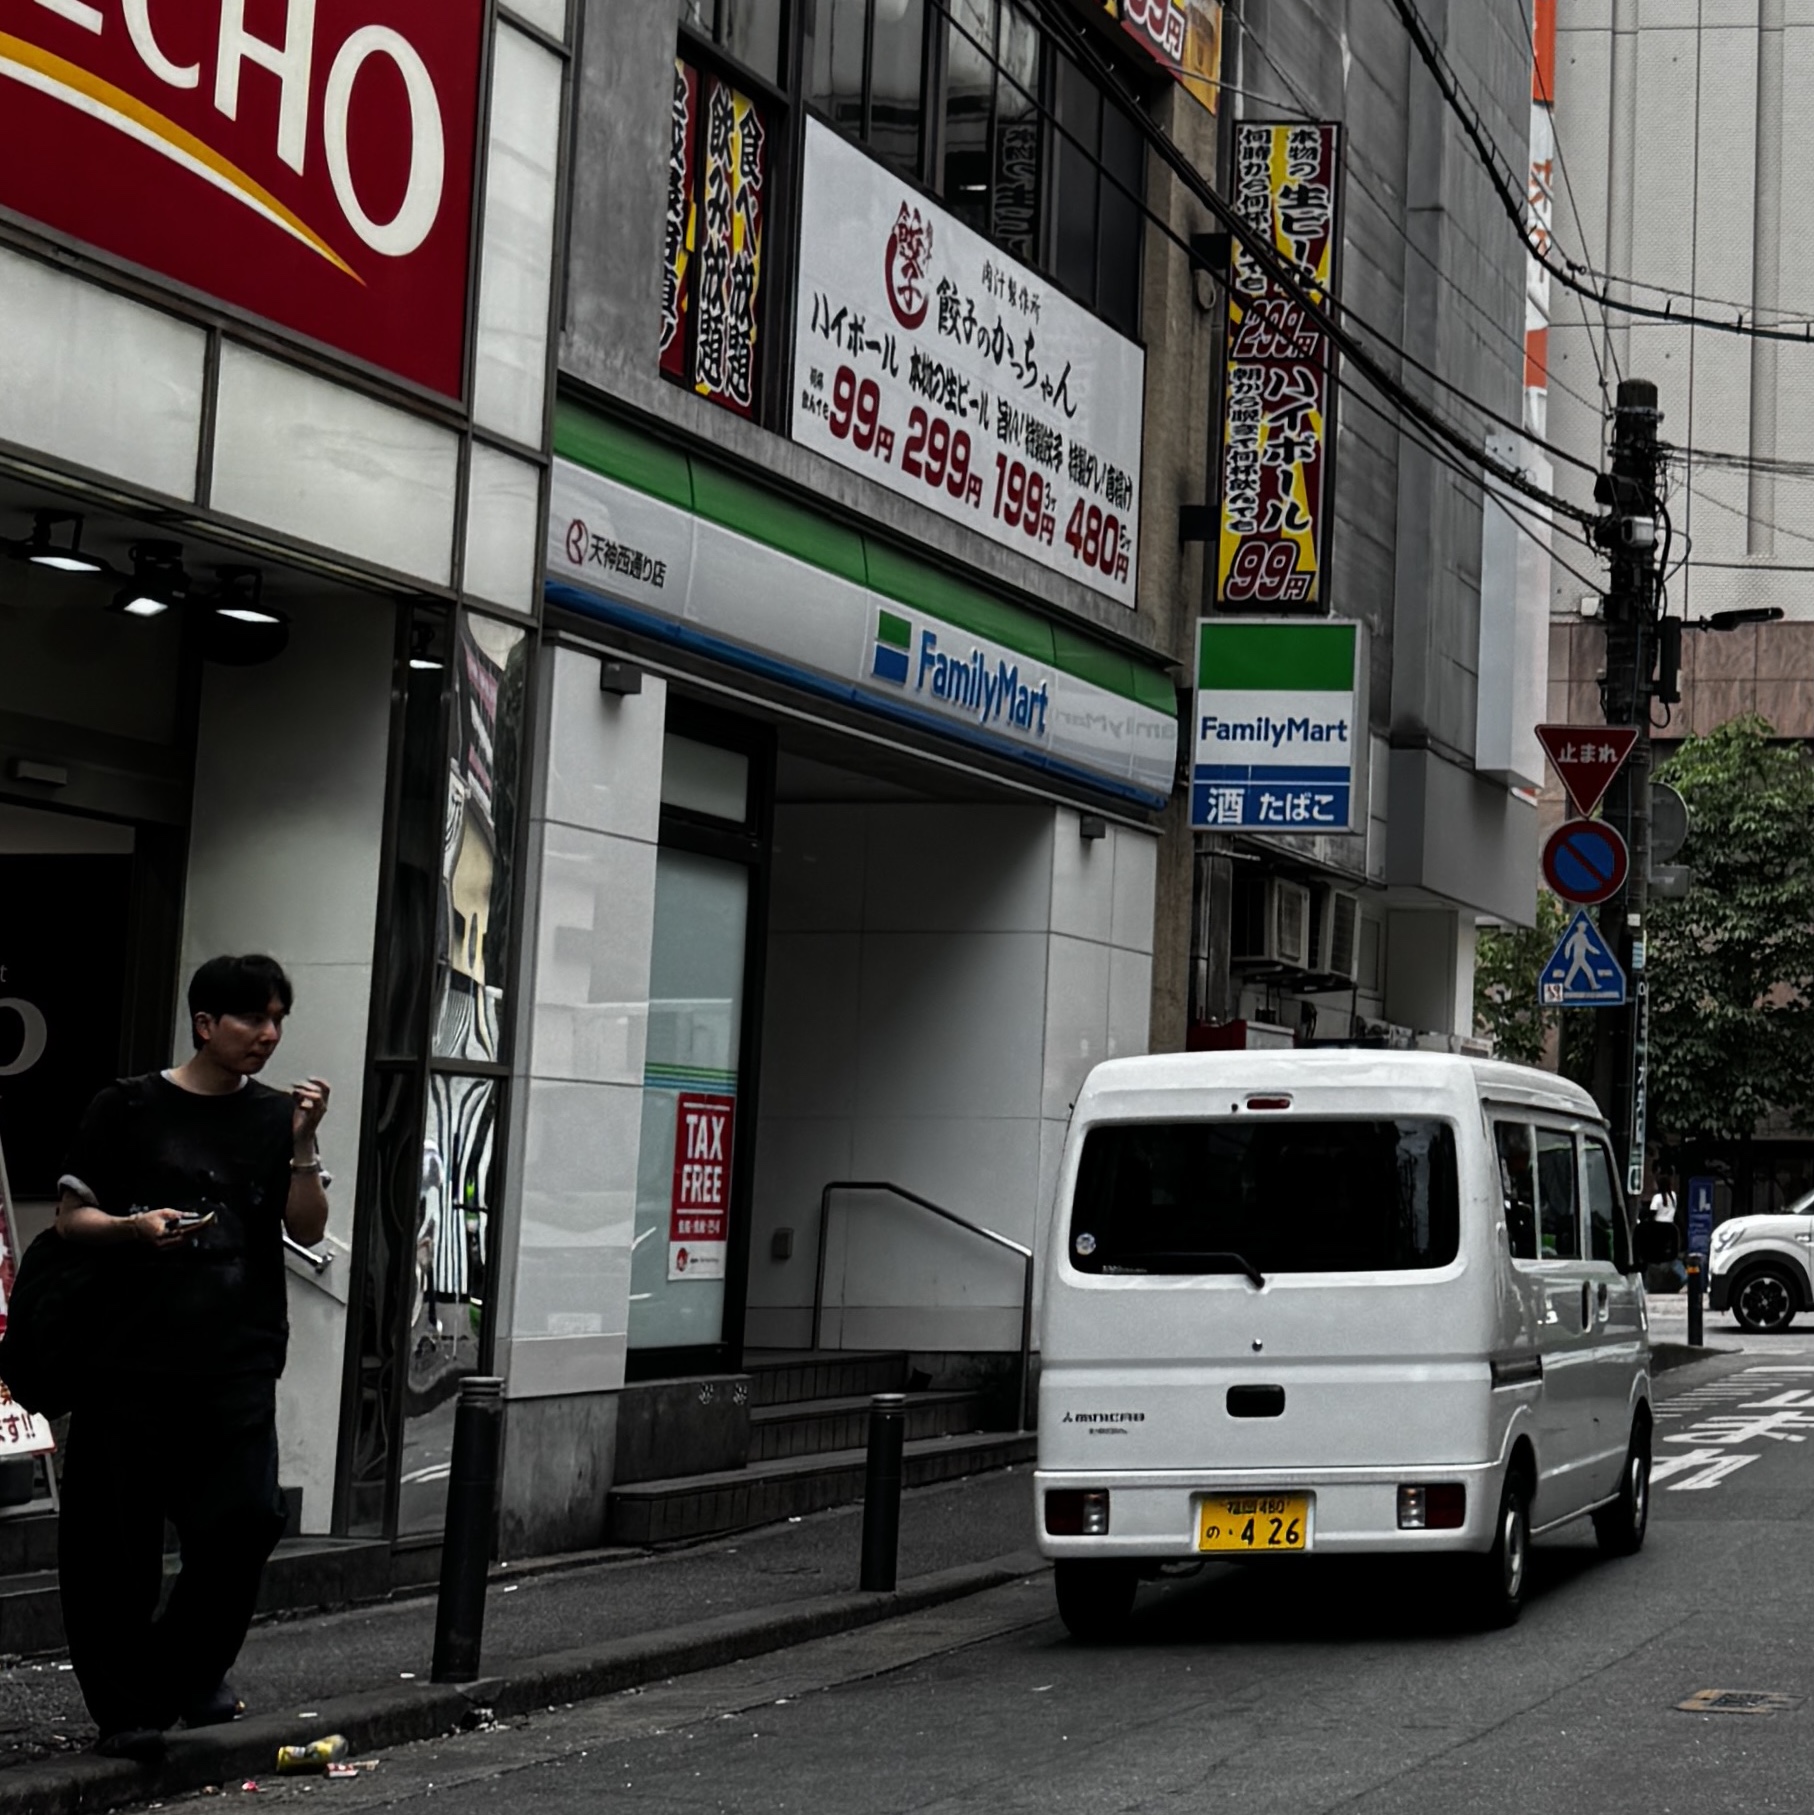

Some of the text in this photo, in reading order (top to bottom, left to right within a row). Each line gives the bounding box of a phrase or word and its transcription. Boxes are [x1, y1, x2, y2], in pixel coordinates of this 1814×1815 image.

[812, 291, 898, 378] ハイボール
[936, 276, 1077, 418] 餃子のかっちゃん
[1260, 366, 1318, 533] ハイボール
[588, 533, 667, 590] 天神西通り店
[1225, 541, 1311, 600] 99円
[917, 630, 1050, 738] FamilyMart
[1201, 716, 1348, 748] FamilyMart
[1558, 744, 1618, 763] 止まれ
[1208, 788, 1335, 824] 酒 たばこ
[686, 1114, 726, 1161] TAX
[681, 1164, 723, 1204] FREE
[1206, 1526, 1221, 1540] の
